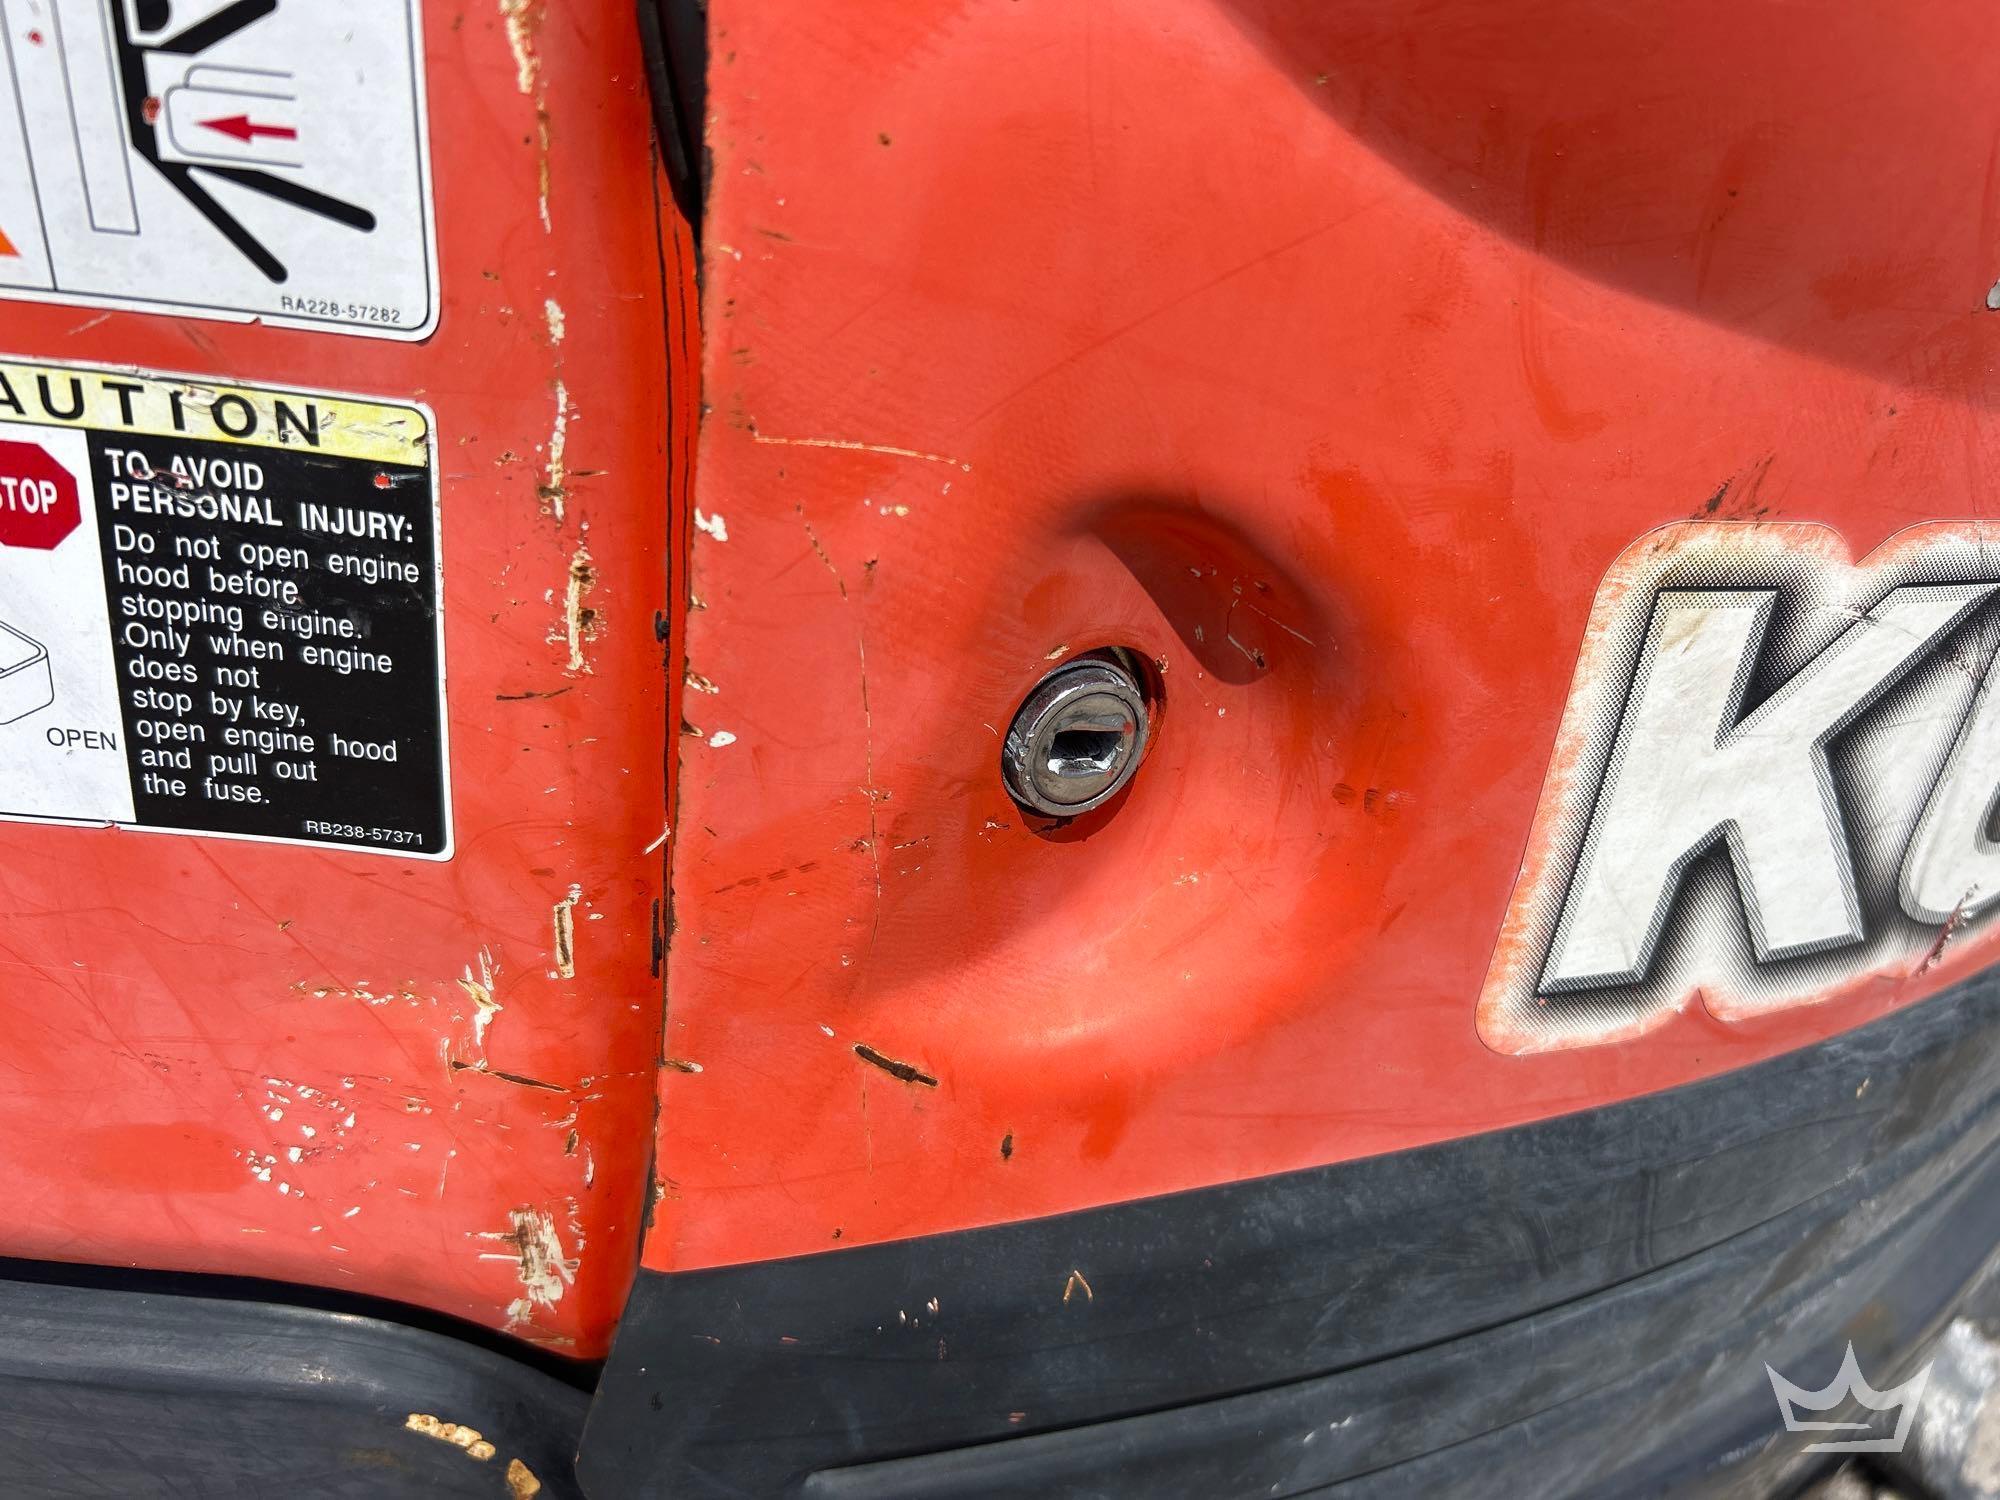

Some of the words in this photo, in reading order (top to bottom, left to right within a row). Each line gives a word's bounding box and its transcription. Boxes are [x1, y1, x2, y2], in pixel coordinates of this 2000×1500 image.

[280, 295, 401, 324] RA228-57282
[104, 448, 153, 480] TO
[171, 456, 264, 491] AVOID
[0, 477, 58, 515] TOP
[110, 482, 284, 527] PERSONAL
[301, 503, 414, 543] INJURY:
[114, 525, 155, 554] Do
[175, 533, 221, 561] not
[239, 544, 309, 576] open
[328, 554, 420, 584] engine
[117, 558, 190, 590] hood
[209, 566, 299, 601] before
[121, 596, 243, 632] stopping
[263, 612, 363, 640] engine.
[125, 622, 191, 654] Only
[211, 633, 284, 662] when
[303, 647, 393, 675] engine
[129, 654, 198, 683] does
[217, 664, 260, 689] not
[133, 686, 192, 716] stop
[212, 691, 242, 723] by
[253, 696, 306, 728] key,
[46, 726, 118, 752] OPEN
[136, 721, 206, 747] open
[224, 723, 315, 755] engine
[333, 733, 398, 763] hood
[141, 747, 192, 771] and
[211, 752, 257, 780] pull
[276, 758, 318, 783] out
[143, 772, 187, 797] the
[204, 778, 271, 805] fuse.
[306, 820, 424, 846] RB238-57371
